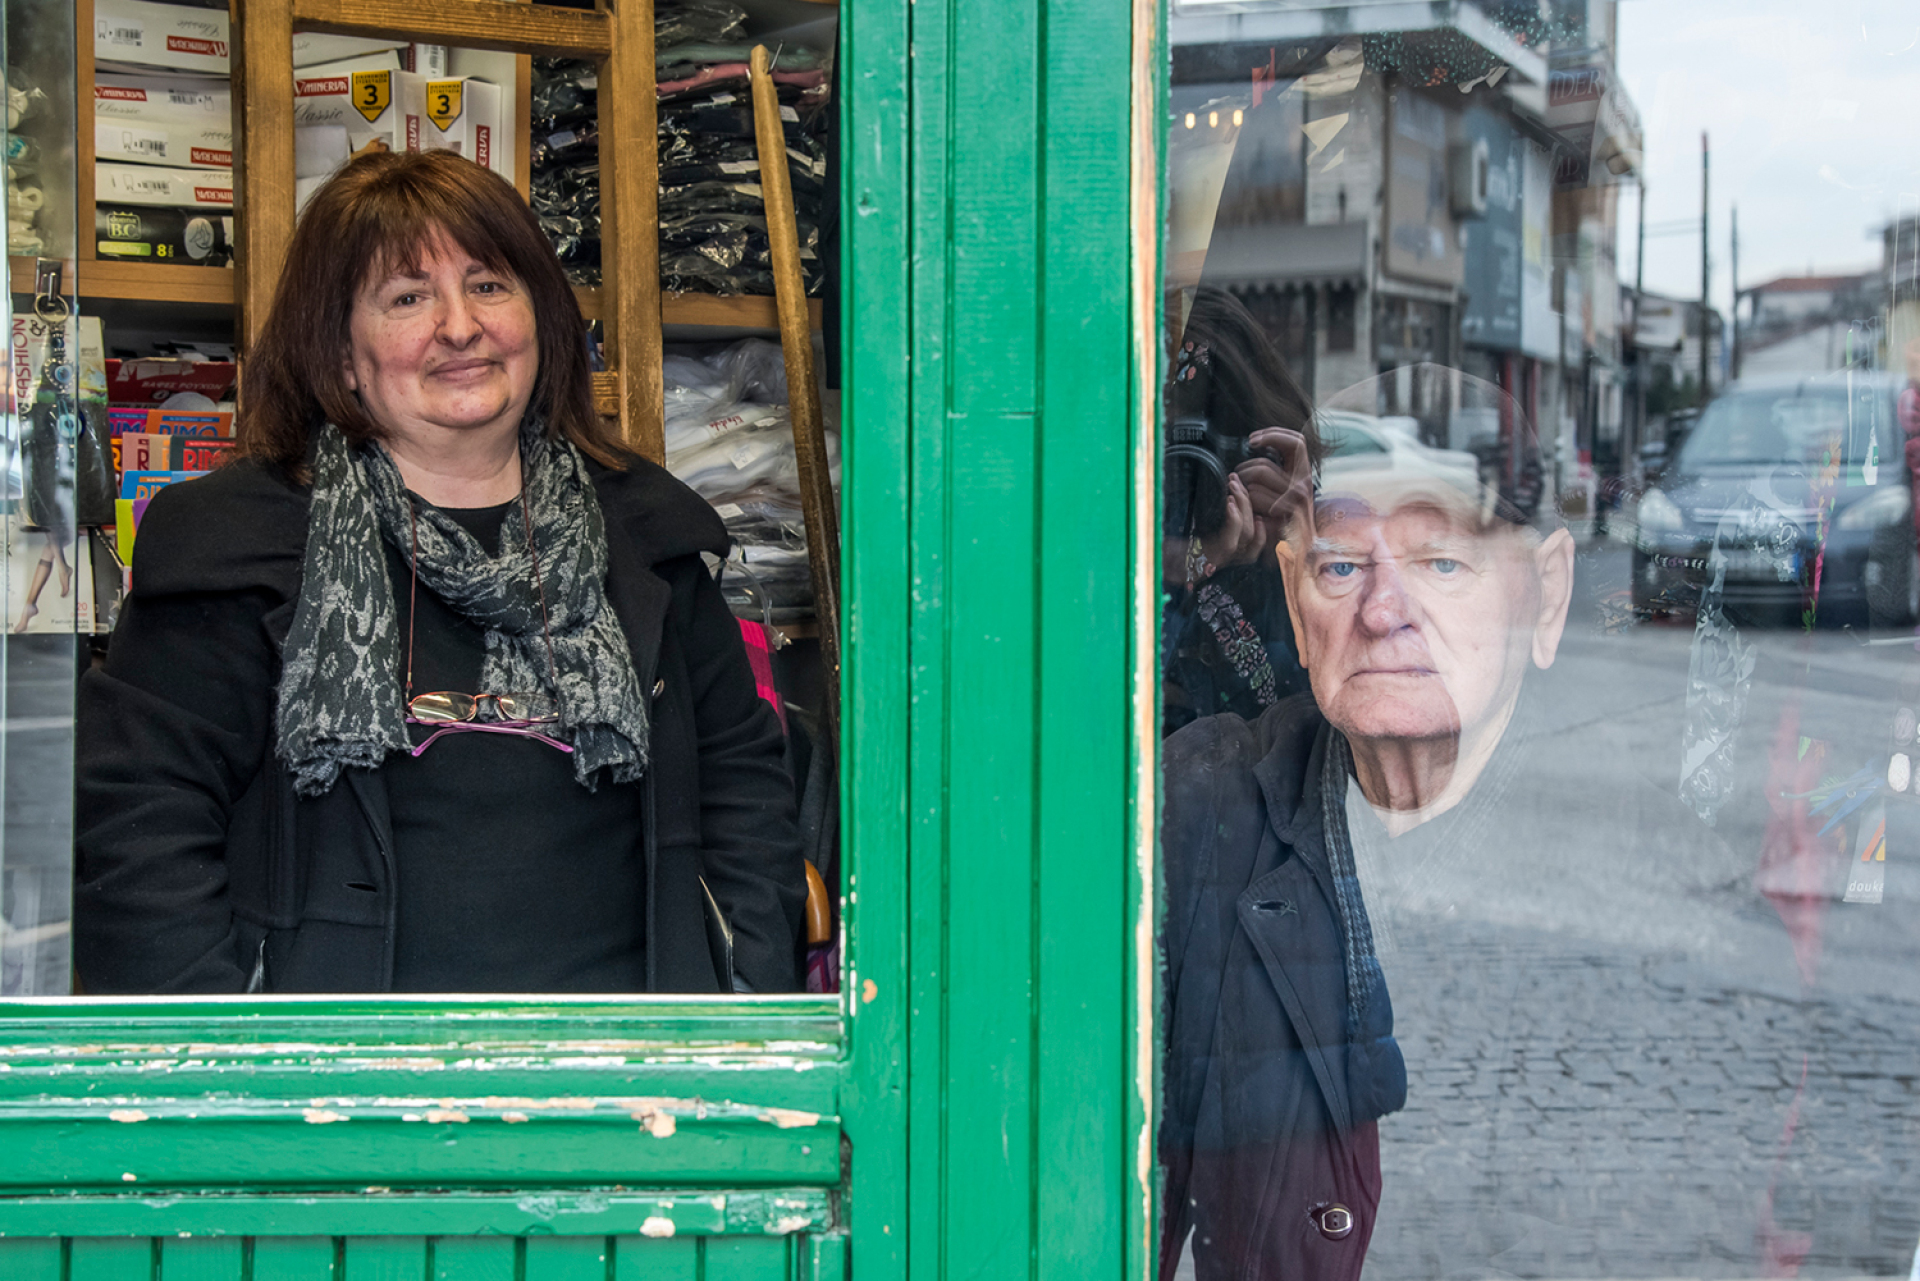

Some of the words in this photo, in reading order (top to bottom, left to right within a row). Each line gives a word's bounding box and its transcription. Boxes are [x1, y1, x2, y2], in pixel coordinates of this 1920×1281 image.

[303, 81, 348, 93] MINERVA
[363, 84, 378, 105] 3
[436, 94, 450, 115] 3
[13, 318, 32, 399] FASHION
